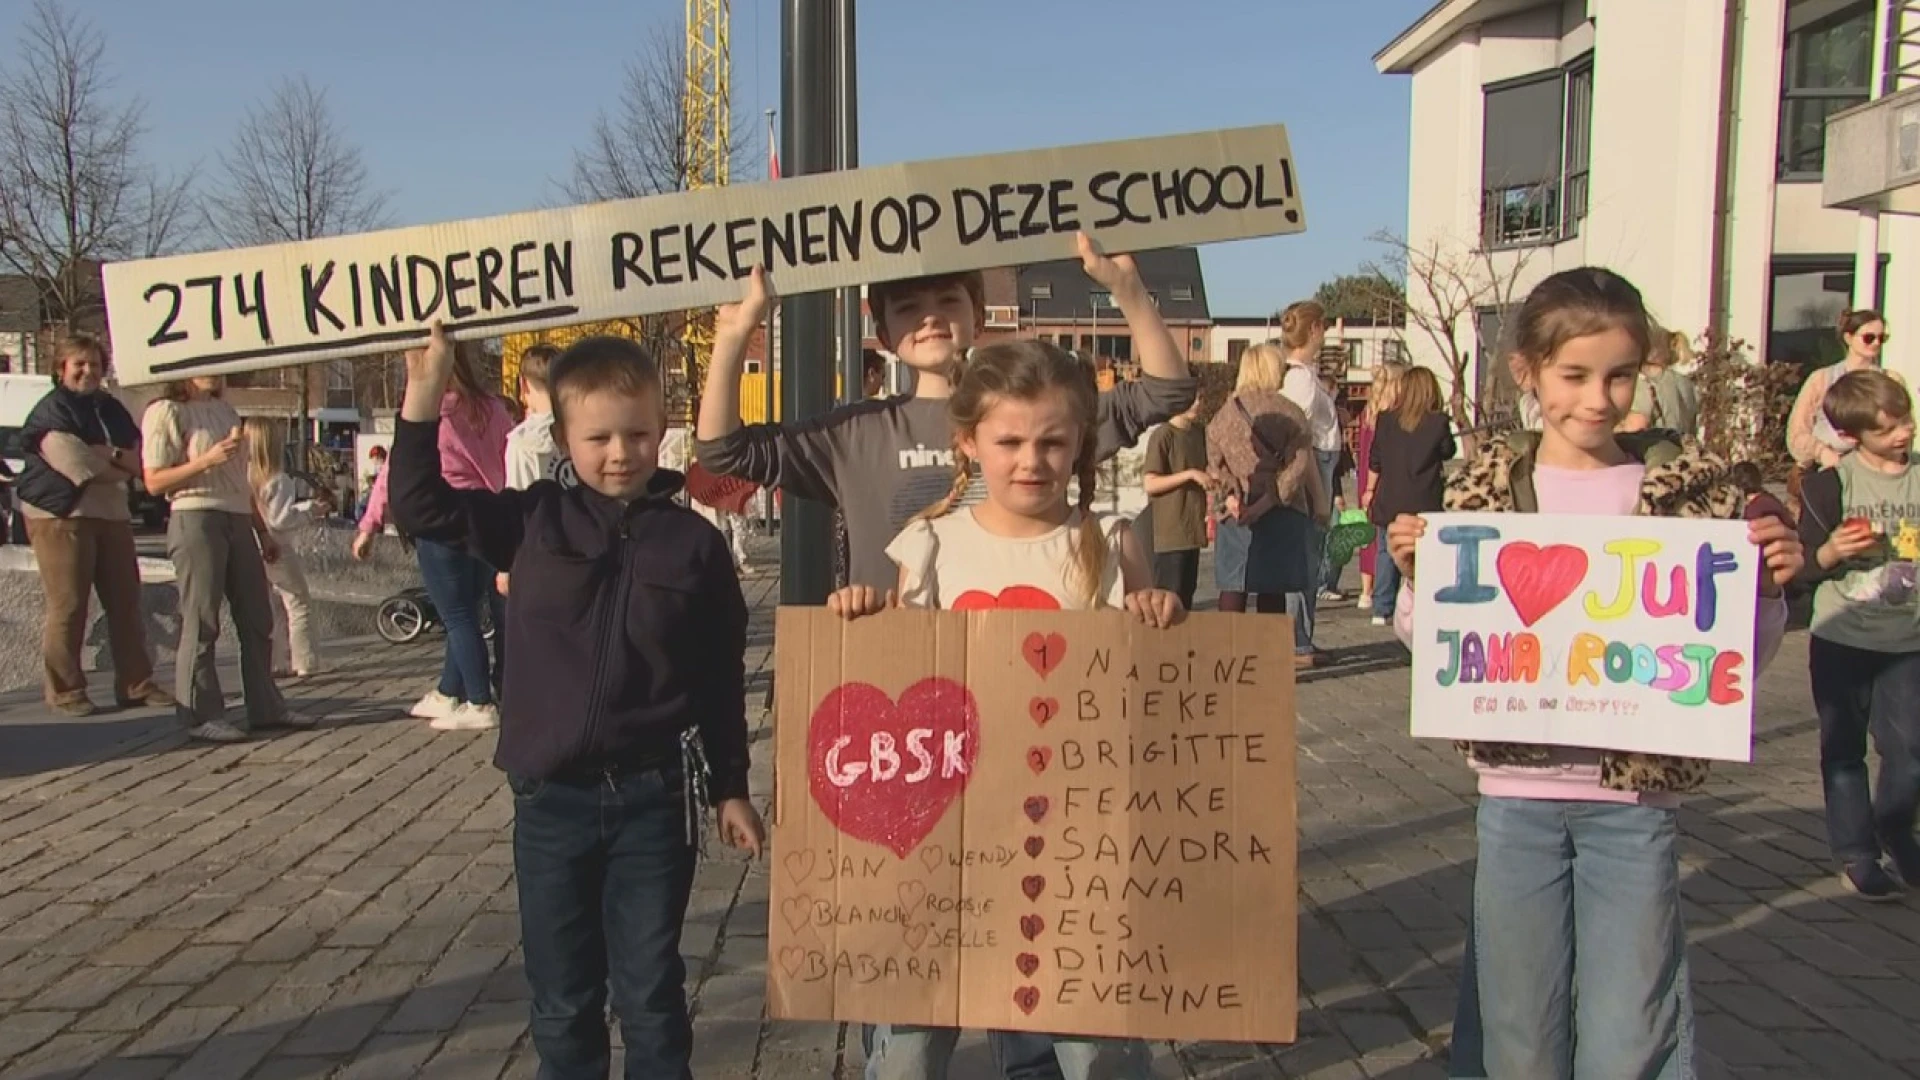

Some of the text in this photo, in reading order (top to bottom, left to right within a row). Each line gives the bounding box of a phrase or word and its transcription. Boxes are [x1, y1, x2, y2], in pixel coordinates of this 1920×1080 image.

[144, 158, 1300, 347] 274 KINDEREN REKENEN OP DEZE SCHOOL!
[1433, 525, 1501, 604] I
[1436, 629, 1541, 687] JANA
[1567, 632, 1745, 706] ROOSJE
[824, 728, 968, 788] GBSK
[1066, 783, 1225, 817] FEMKE
[948, 846, 1018, 869] WENDY
[1054, 827, 1272, 866] SANDRA
[1058, 910, 1133, 941] ELS
[802, 950, 941, 984] BABARA
[1057, 979, 1243, 1014] EVELYNE
